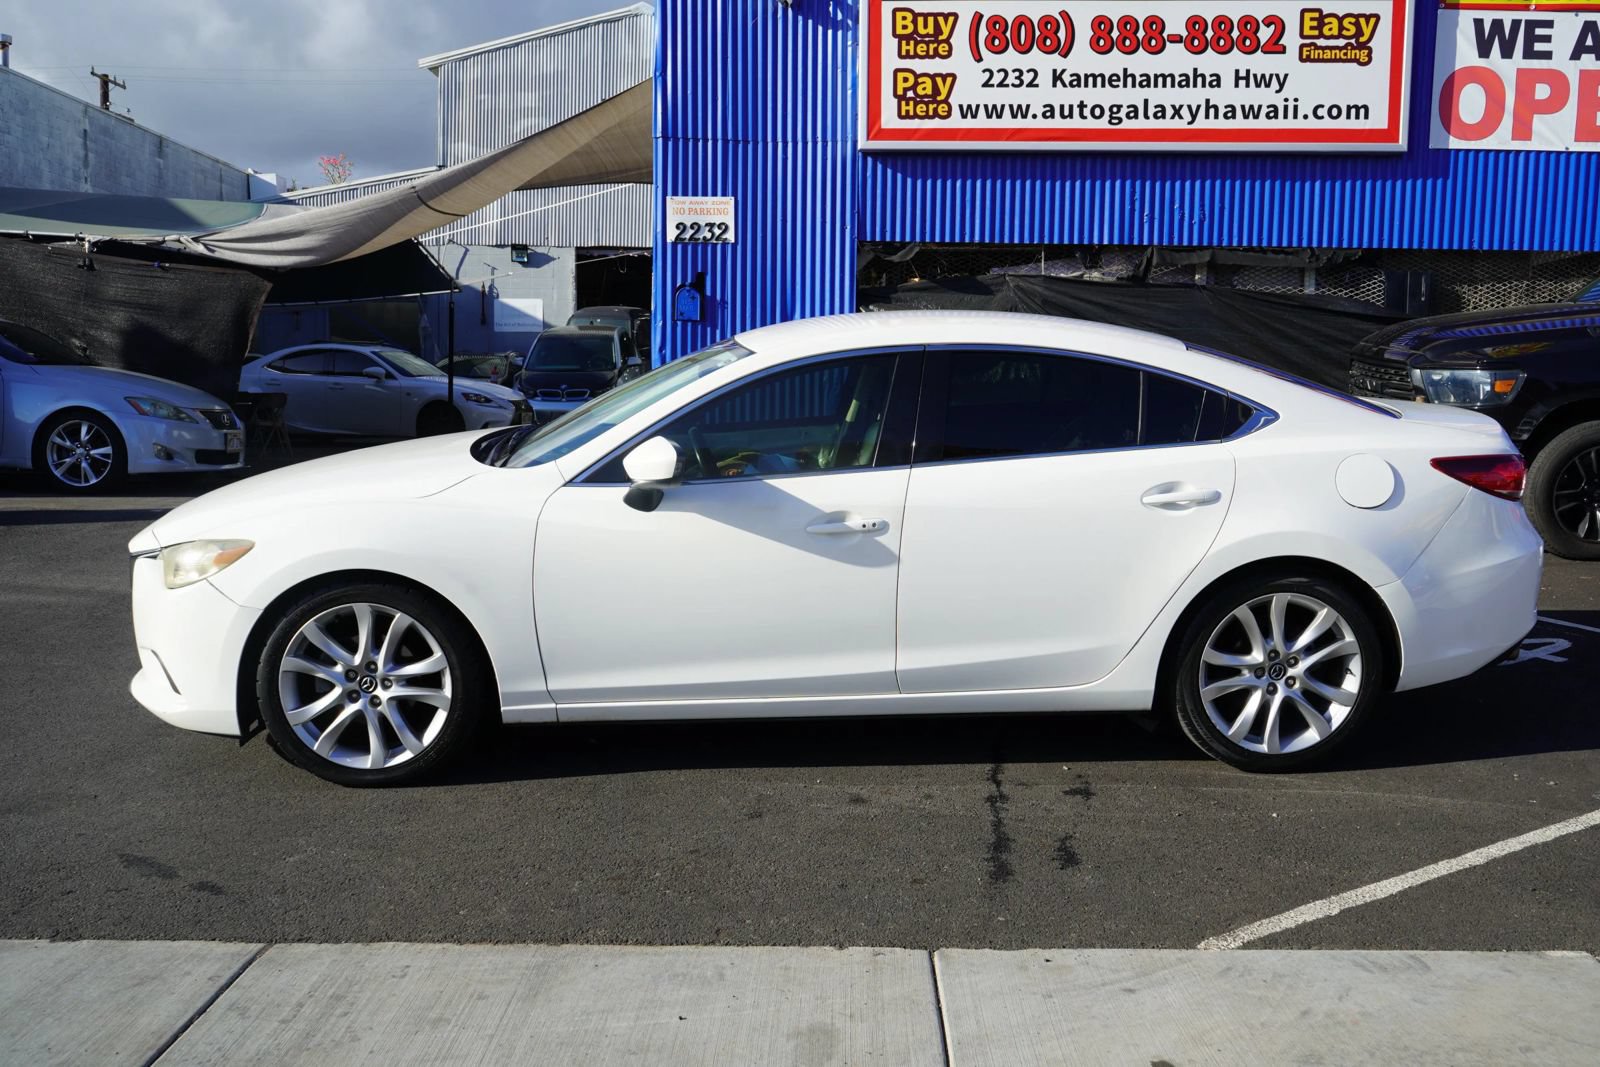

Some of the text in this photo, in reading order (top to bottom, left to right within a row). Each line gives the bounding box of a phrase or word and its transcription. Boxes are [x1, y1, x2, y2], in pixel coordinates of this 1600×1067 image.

[894, 10, 956, 40] Buy
[969, 11, 1286, 62] (808) 888-8882
[1302, 11, 1377, 43] Easy
[1473, 18, 1555, 60] WE
[901, 40, 950, 56] Here
[1301, 45, 1370, 63] Financing
[896, 71, 954, 101] Pay
[981, 67, 1289, 94] 2232 Kamehamaha Hwy
[900, 100, 949, 116] Here
[958, 97, 1370, 126] www.autogalaxyhawaii.com
[672, 207, 729, 216] NO PARKING
[674, 221, 730, 242] 2232
